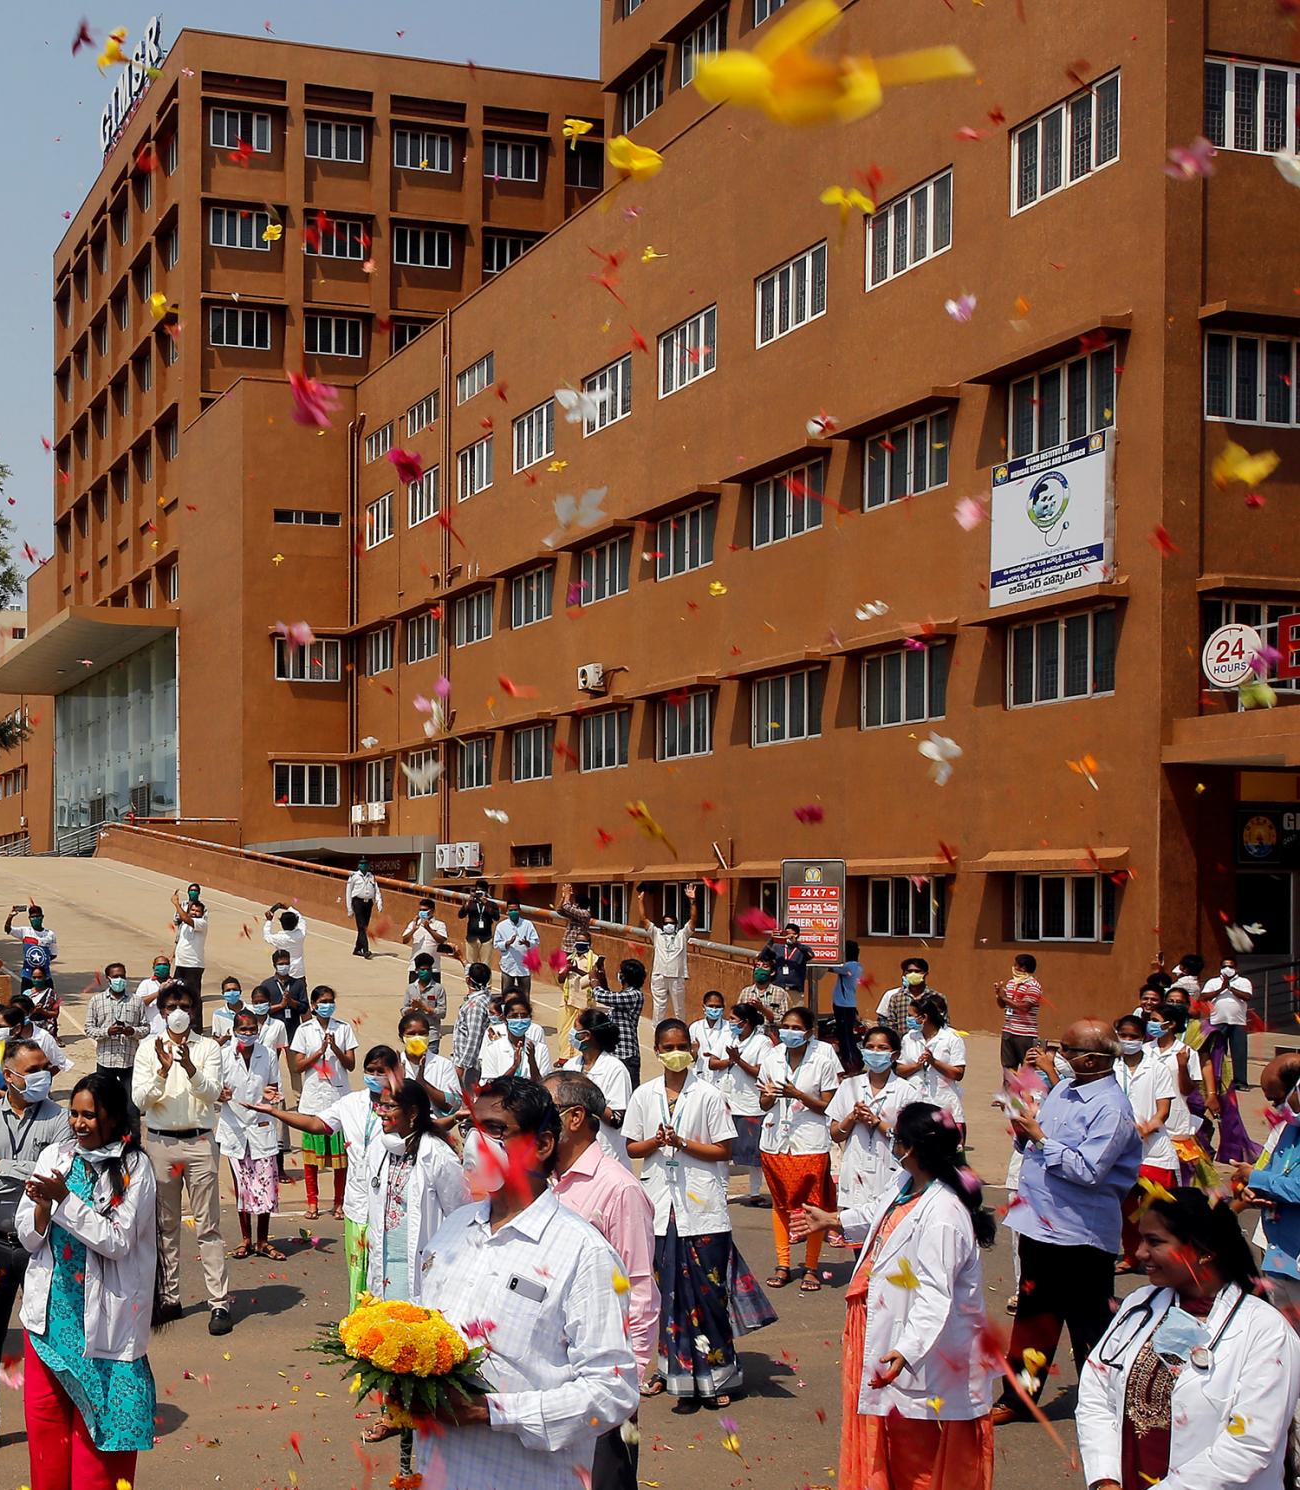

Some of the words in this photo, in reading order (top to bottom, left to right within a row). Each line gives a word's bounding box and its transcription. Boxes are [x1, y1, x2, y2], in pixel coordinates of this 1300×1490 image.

[1040, 448, 1063, 462] INSTITUTE
[1063, 444, 1070, 454] OF
[1010, 467, 1030, 479] MEDICAL
[1030, 460, 1052, 473] SCIENCES
[1052, 456, 1062, 466] AND
[1062, 447, 1086, 462] RESEARCH
[1215, 637, 1245, 664] 24
[1213, 661, 1247, 675] HOURS
[801, 888, 811, 897] 24
[812, 888, 819, 897] X
[821, 889, 827, 897] 7
